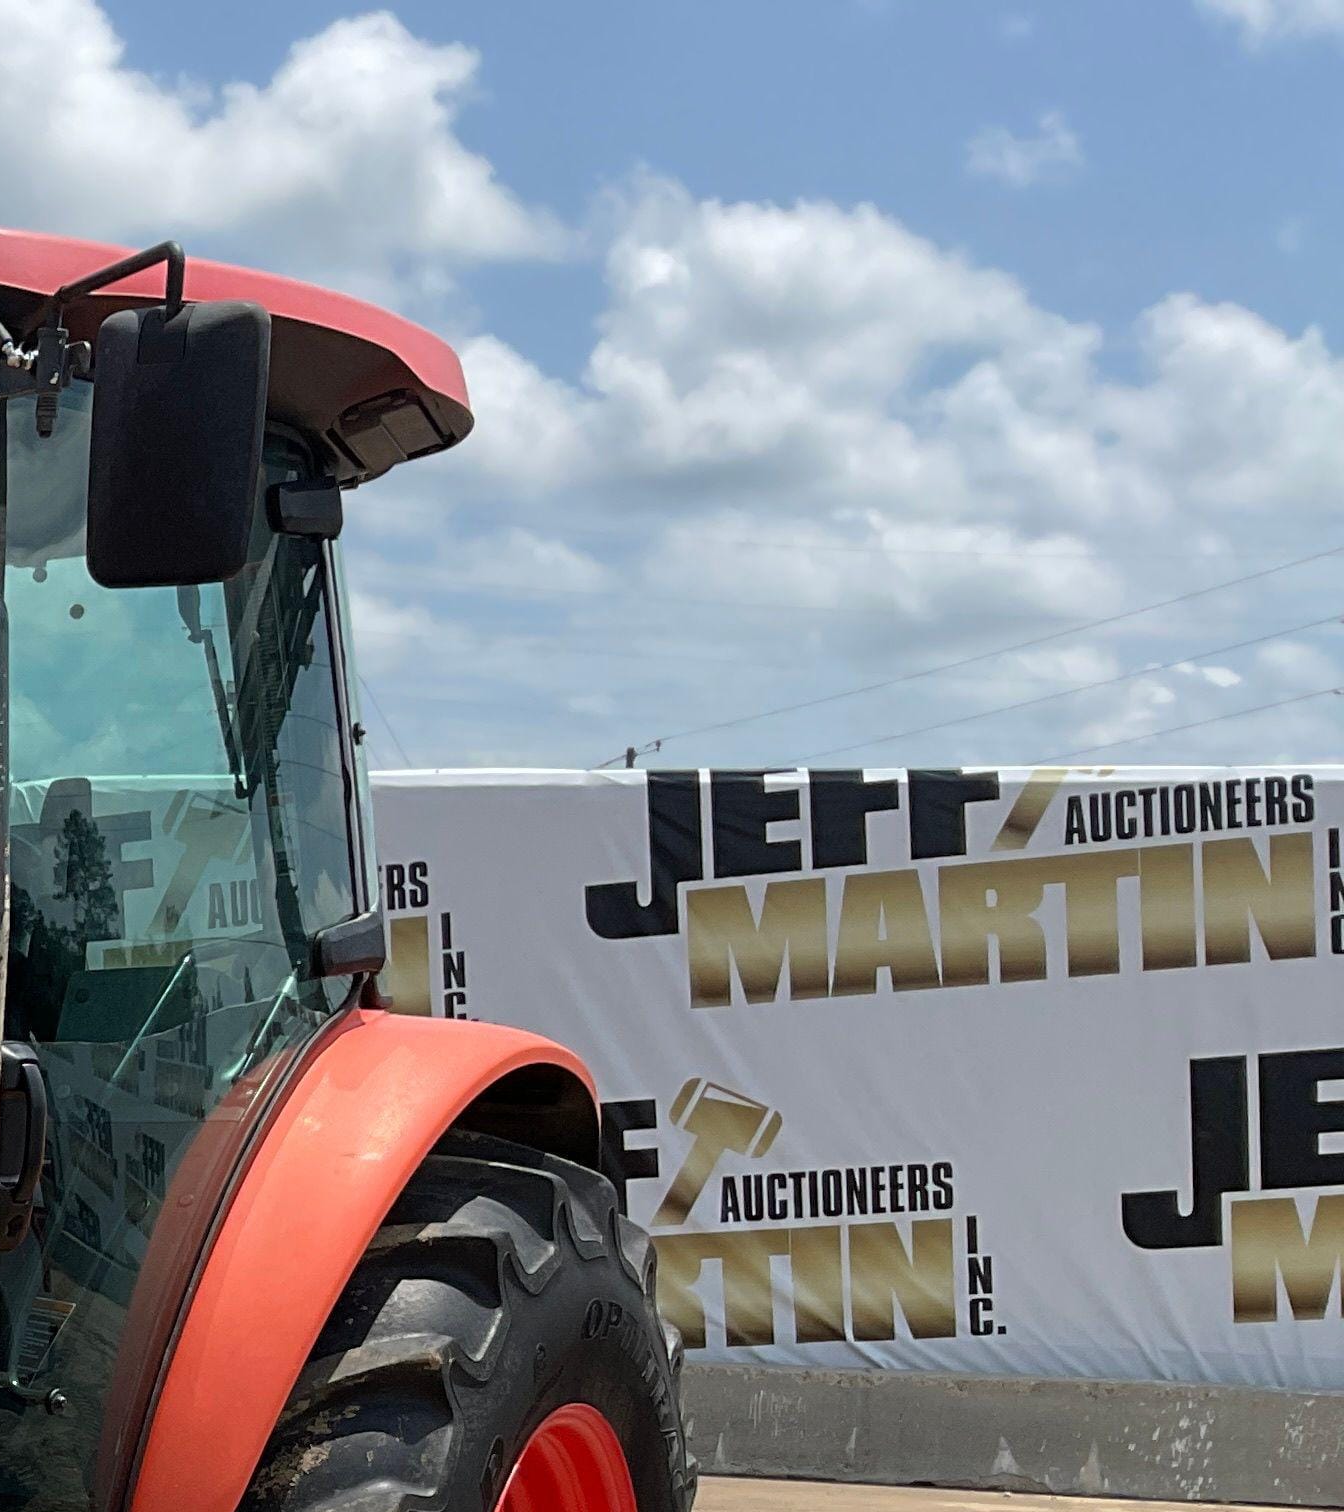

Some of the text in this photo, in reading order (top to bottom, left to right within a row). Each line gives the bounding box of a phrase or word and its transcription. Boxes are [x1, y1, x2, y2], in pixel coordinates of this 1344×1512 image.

[585, 769, 1000, 939] JEFF
[1064, 773, 1315, 846] AUCTIONEERS
[686, 831, 1317, 1010] MARTIN
[720, 1161, 955, 1224] AUCTIONEERS
[966, 1214, 1008, 1337] INC.
